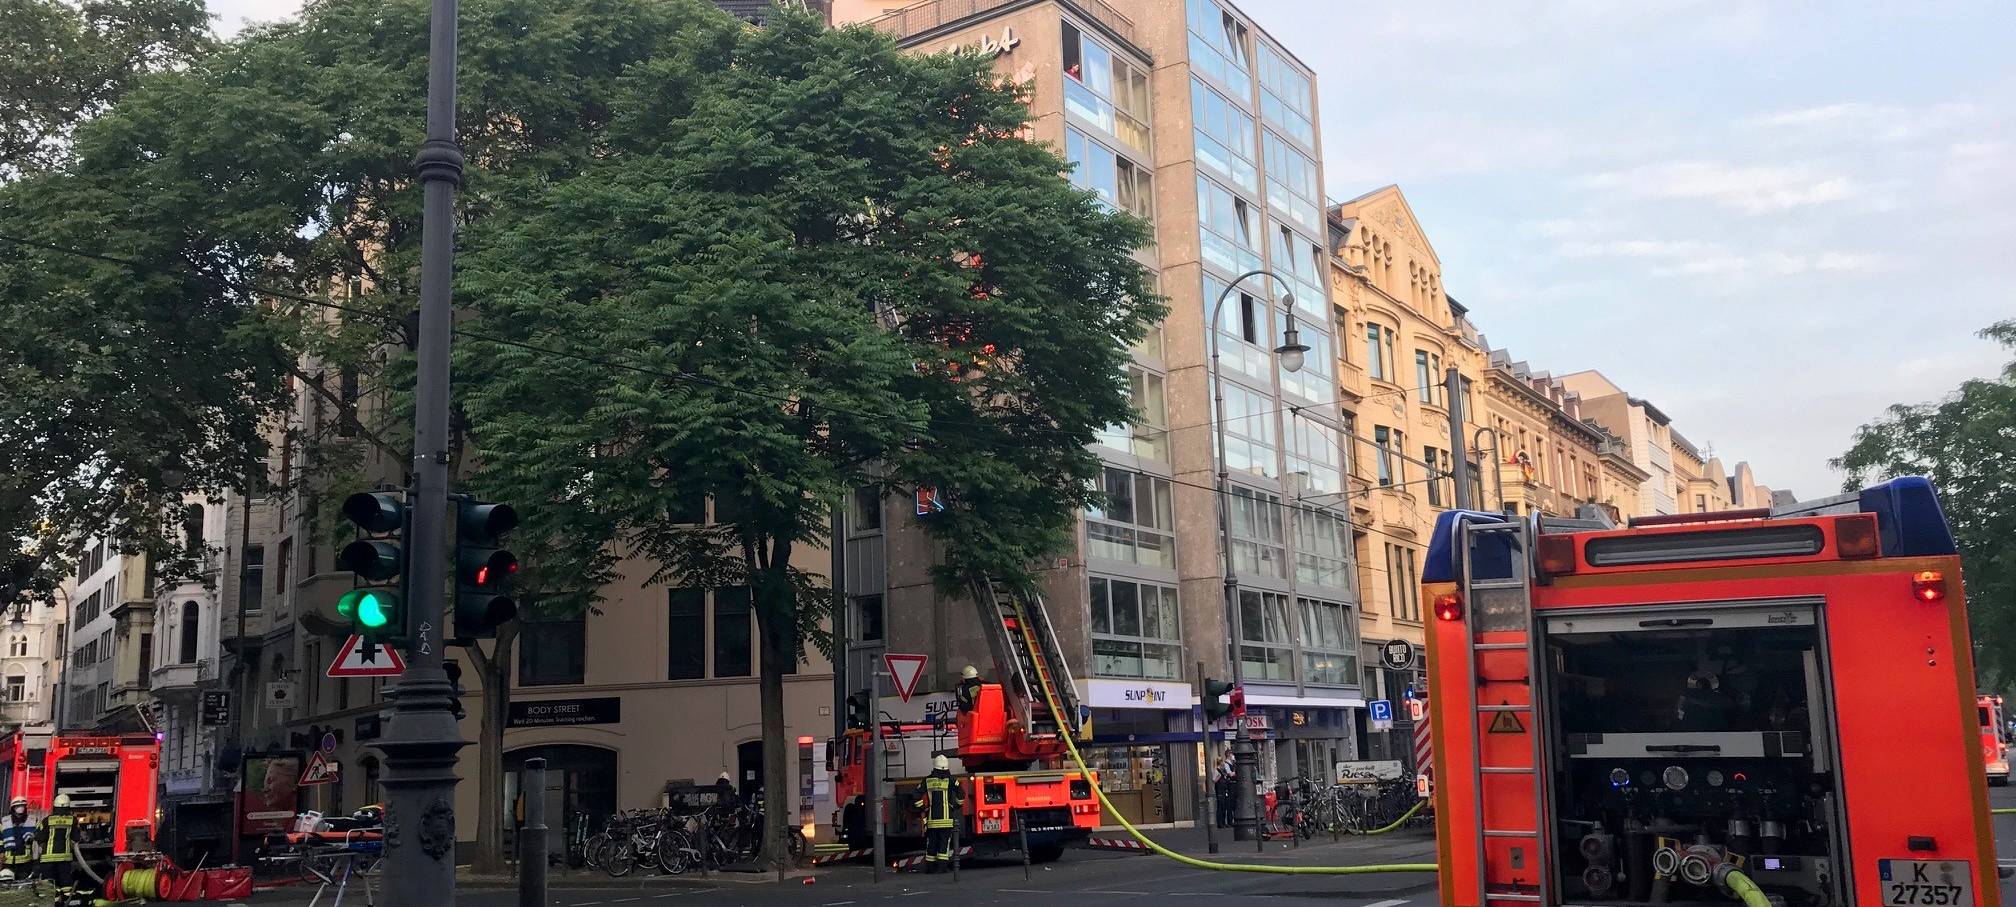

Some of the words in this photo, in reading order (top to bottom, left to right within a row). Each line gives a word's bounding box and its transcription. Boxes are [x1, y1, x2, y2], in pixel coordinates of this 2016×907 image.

[527, 706, 552, 714] BODY
[553, 705, 580, 713] STREET
[926, 701, 958, 712] SUNP
[1375, 703, 1386, 719] P
[1246, 717, 1264, 727] OSK
[1913, 862, 1929, 882] K
[1891, 885, 1962, 905] 27357
